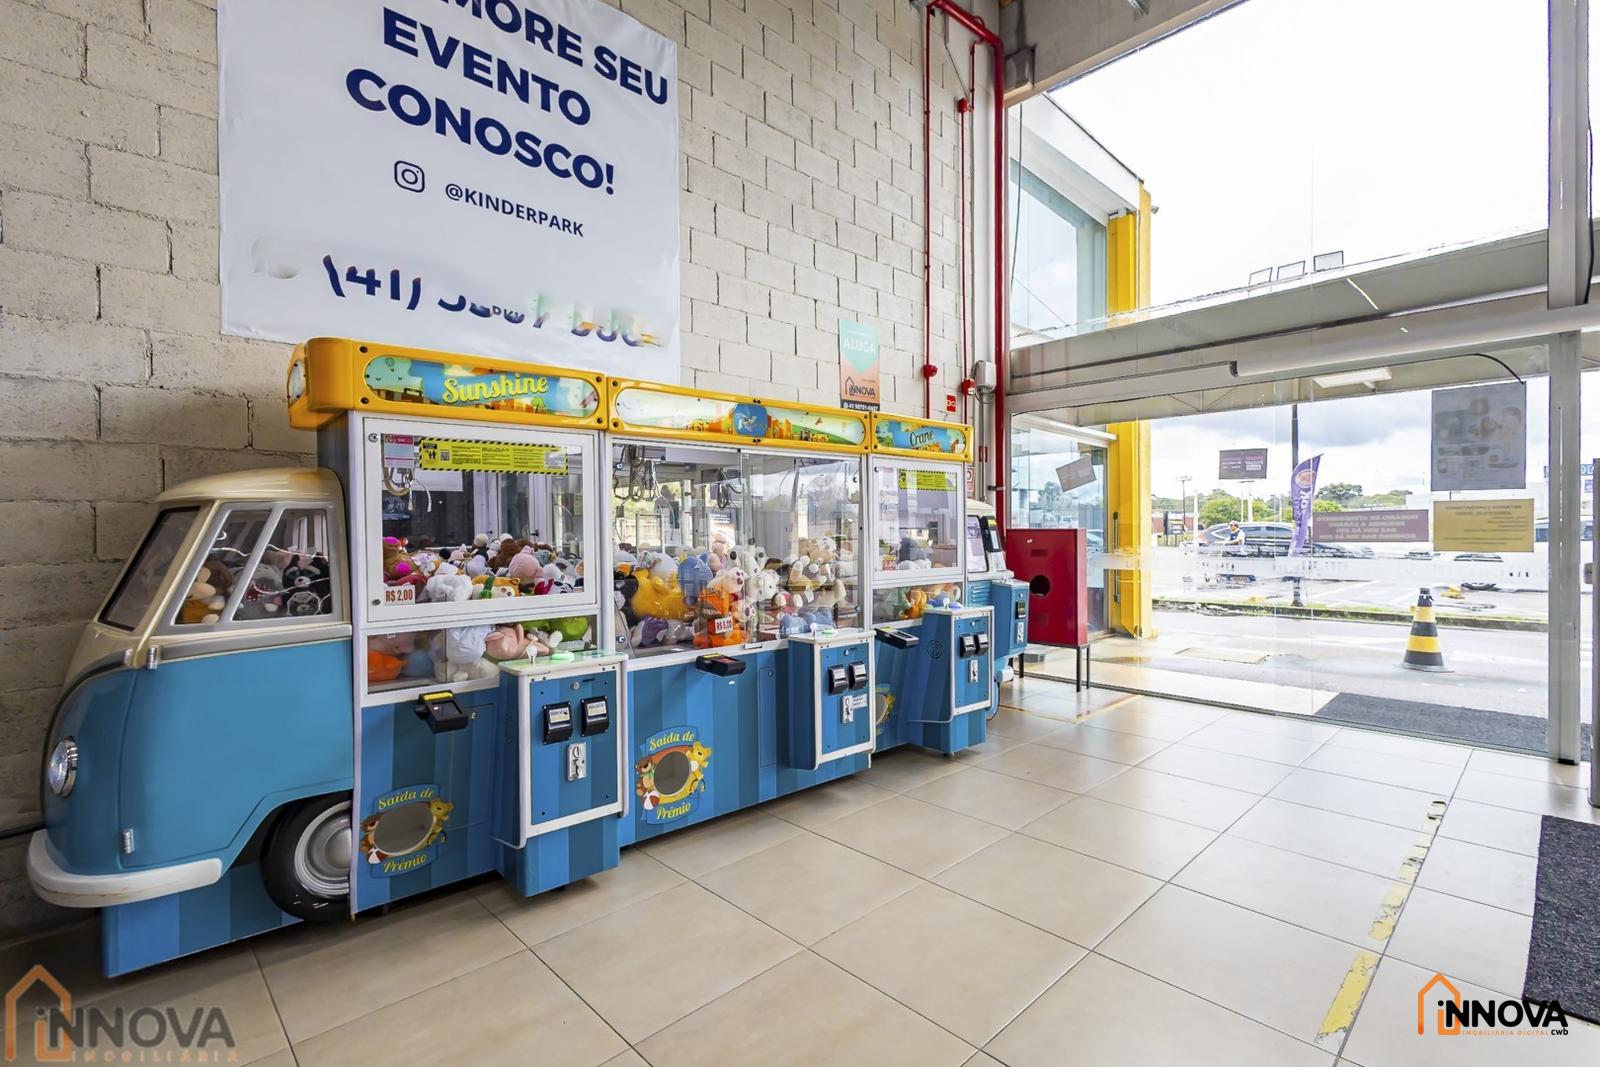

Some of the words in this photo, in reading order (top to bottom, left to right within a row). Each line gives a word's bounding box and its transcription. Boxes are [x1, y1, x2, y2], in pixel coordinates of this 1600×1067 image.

[383, 7, 591, 126] EVENTO
[593, 45, 668, 105] SEU
[346, 68, 615, 195] CONOSCO!
[445, 183, 584, 237] @KINDERPARK
[843, 337, 877, 354] ALUGA
[442, 373, 549, 404] Sunshine
[909, 430, 935, 447] Crane
[385, 590, 396, 602] R$
[682, 730, 695, 742] de
[420, 785, 434, 798] de
